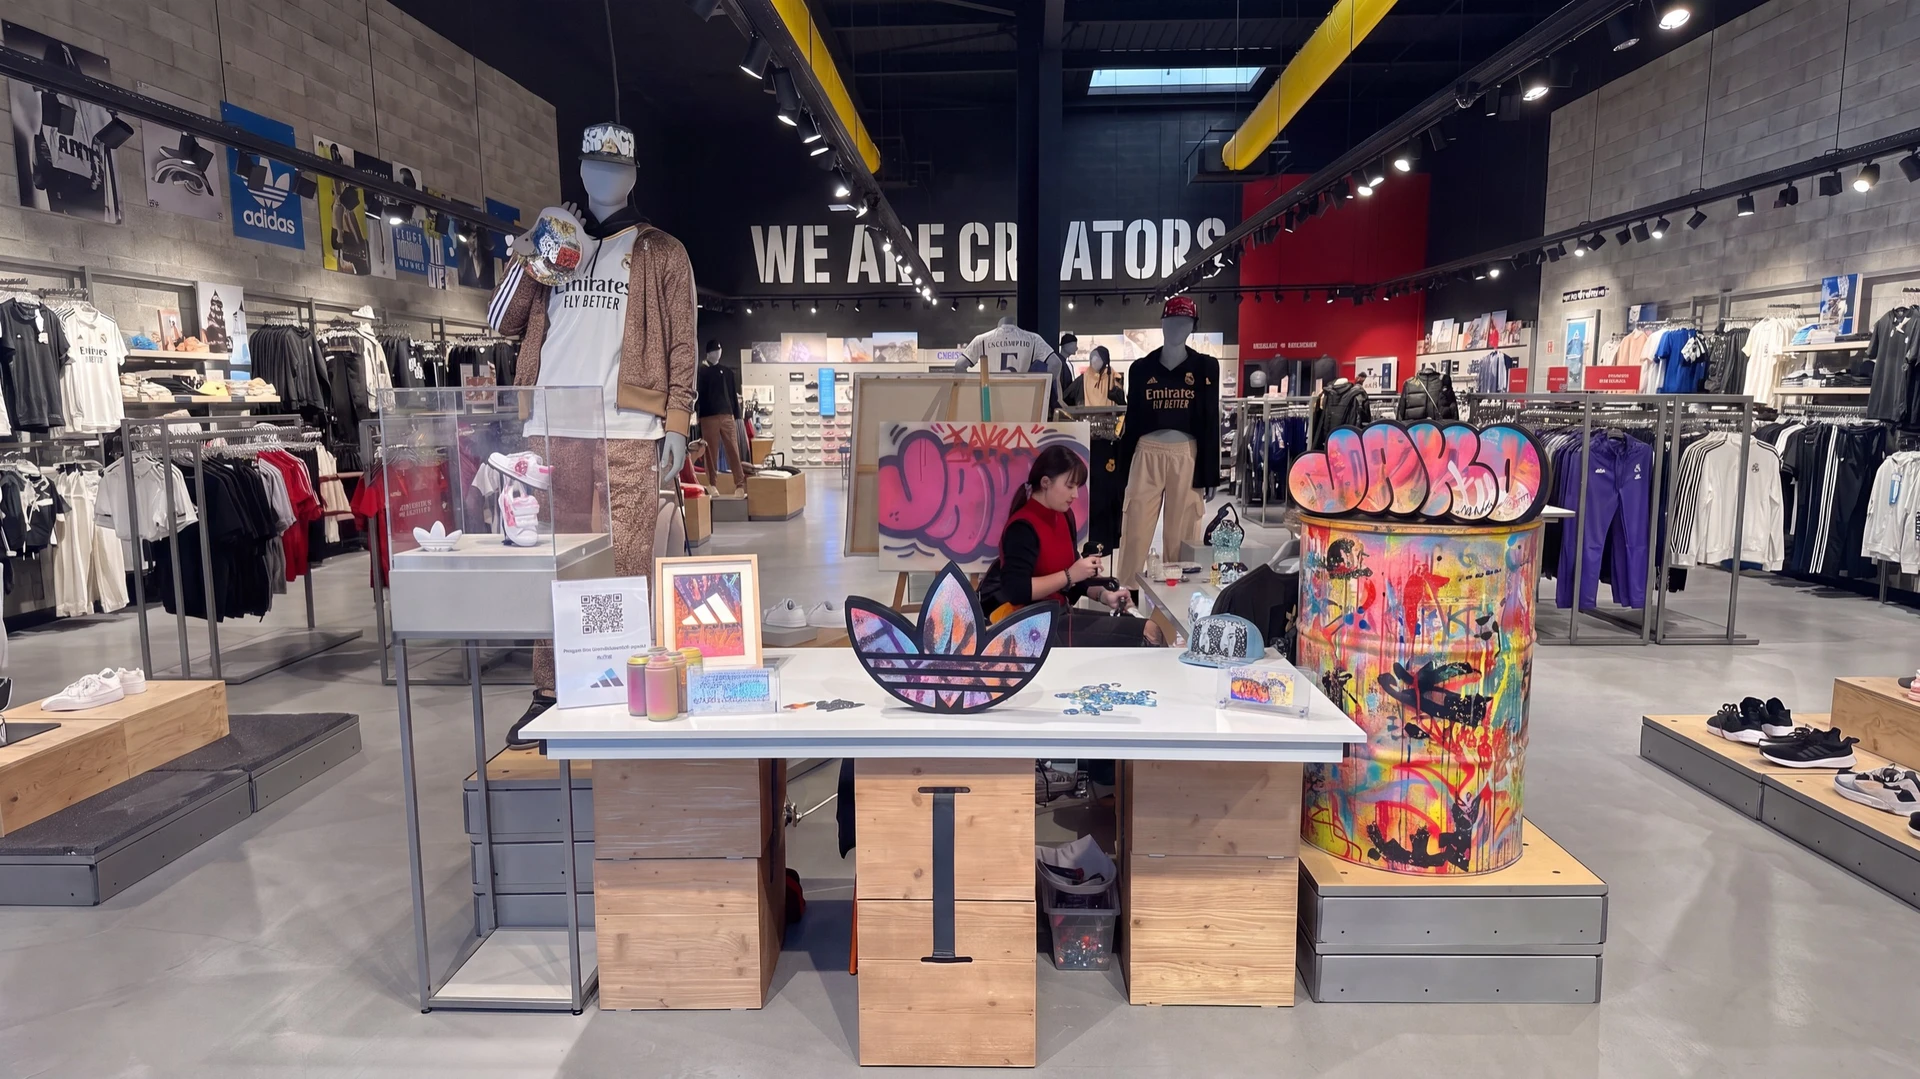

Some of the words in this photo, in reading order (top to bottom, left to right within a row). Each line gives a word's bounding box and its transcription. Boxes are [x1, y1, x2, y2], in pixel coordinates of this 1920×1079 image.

[243, 208, 296, 235] adidas
[750, 224, 831, 284] WE
[958, 217, 1227, 283] CRATORS
[563, 294, 580, 309] FLY
[582, 294, 620, 311] BETTER
[1145, 387, 1195, 400] Emirates
